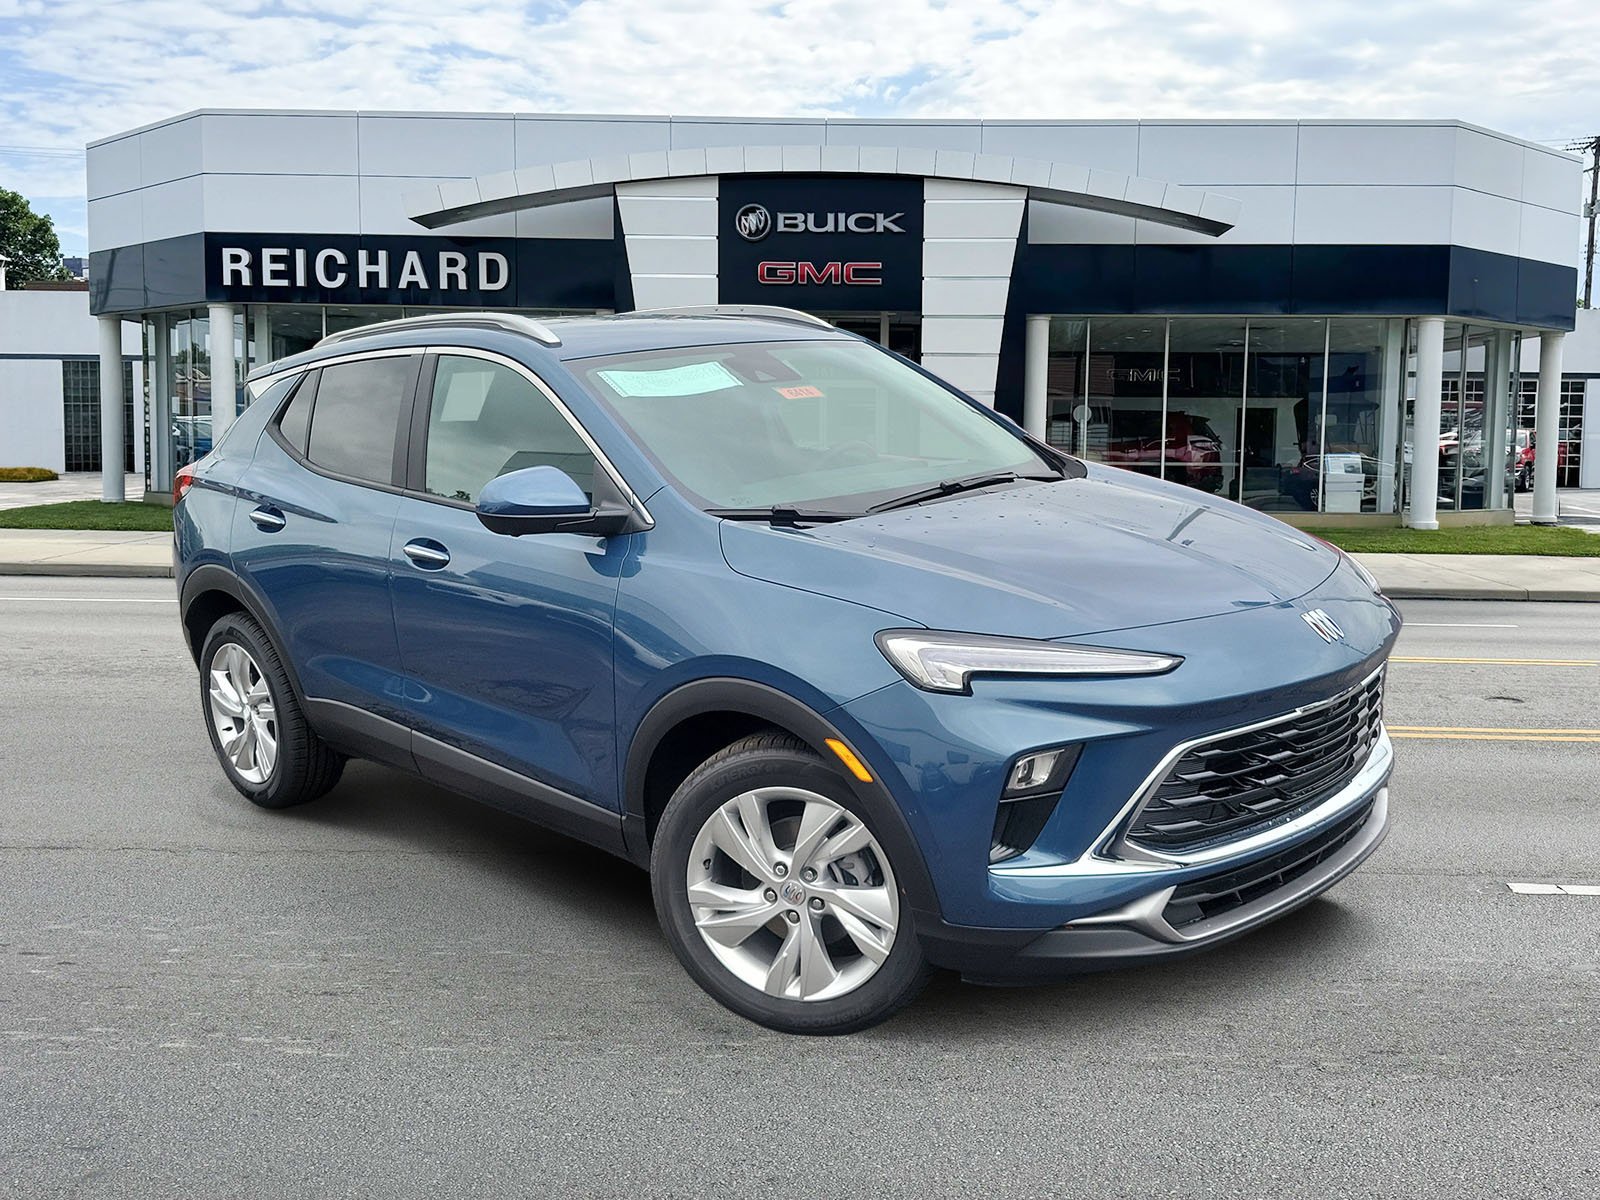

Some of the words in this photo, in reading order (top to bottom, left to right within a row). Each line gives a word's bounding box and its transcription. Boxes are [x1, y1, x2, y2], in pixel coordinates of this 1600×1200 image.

[776, 212, 906, 233] BUICK
[221, 246, 511, 292] REICHARD
[757, 261, 882, 285] GMC
[1106, 368, 1181, 382] GMC
